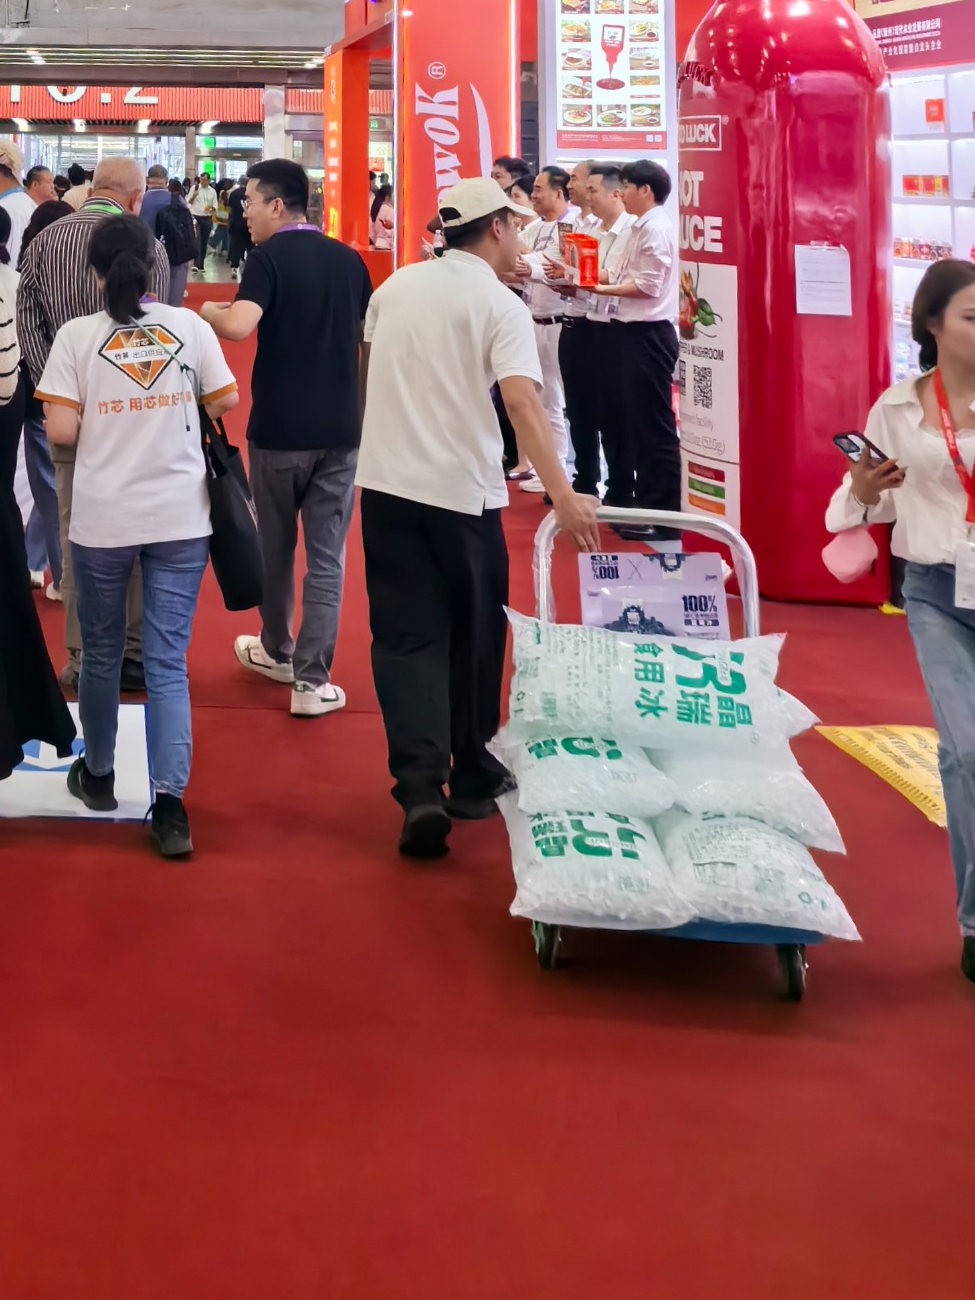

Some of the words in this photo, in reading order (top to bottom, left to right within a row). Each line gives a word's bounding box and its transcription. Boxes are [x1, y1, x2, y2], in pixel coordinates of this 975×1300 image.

[98, 400, 124, 415] 竹芯
[682, 595, 717, 612] 100%
[634, 642, 668, 719] 食用冰
